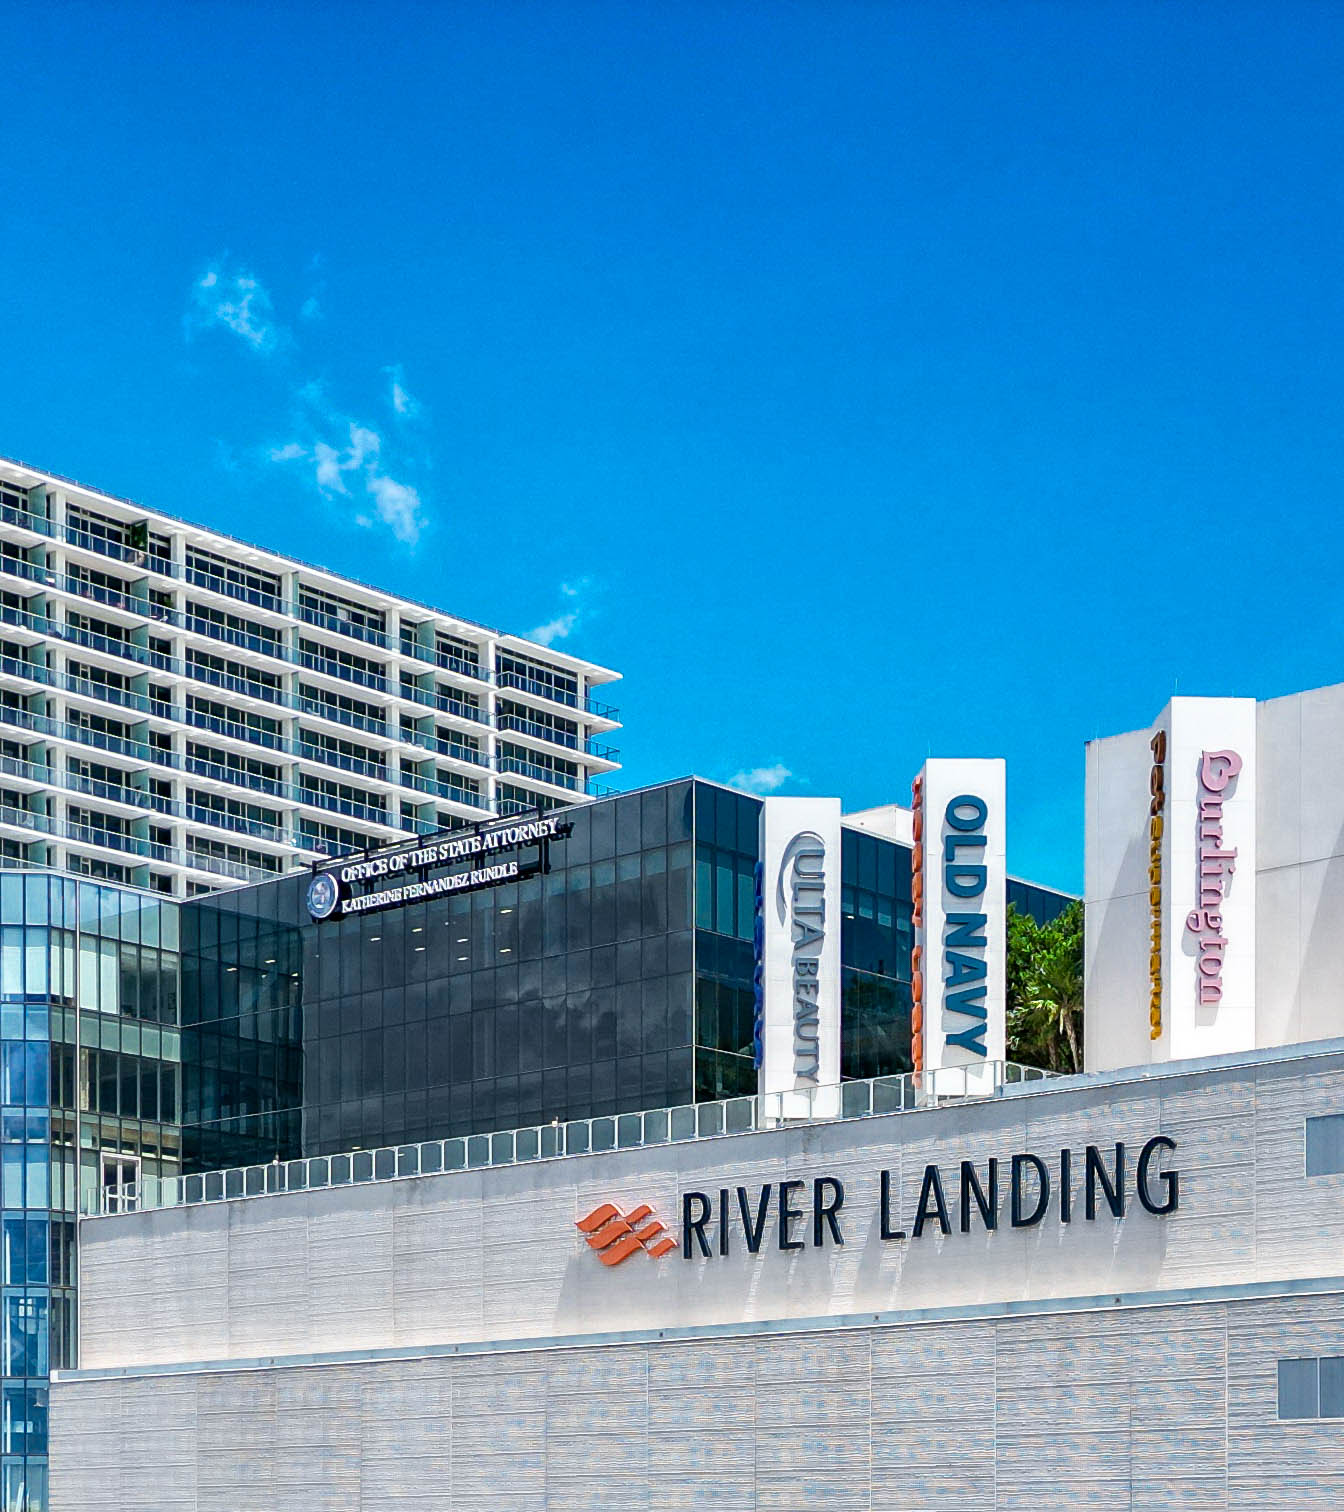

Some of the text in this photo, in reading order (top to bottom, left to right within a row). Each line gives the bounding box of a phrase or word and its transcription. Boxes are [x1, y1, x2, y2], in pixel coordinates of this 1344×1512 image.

[341, 817, 559, 883] OFFICE OF THE STATE ATTORNEY
[342, 861, 518, 913] KATHERINE FERNANDEZ RUNDLE
[945, 794, 988, 1058] OLD NAVY
[1186, 748, 1242, 1005] Burlington
[794, 849, 826, 1083] ULTA BEAUTY
[682, 1136, 1180, 1260] RIVER LANDING
